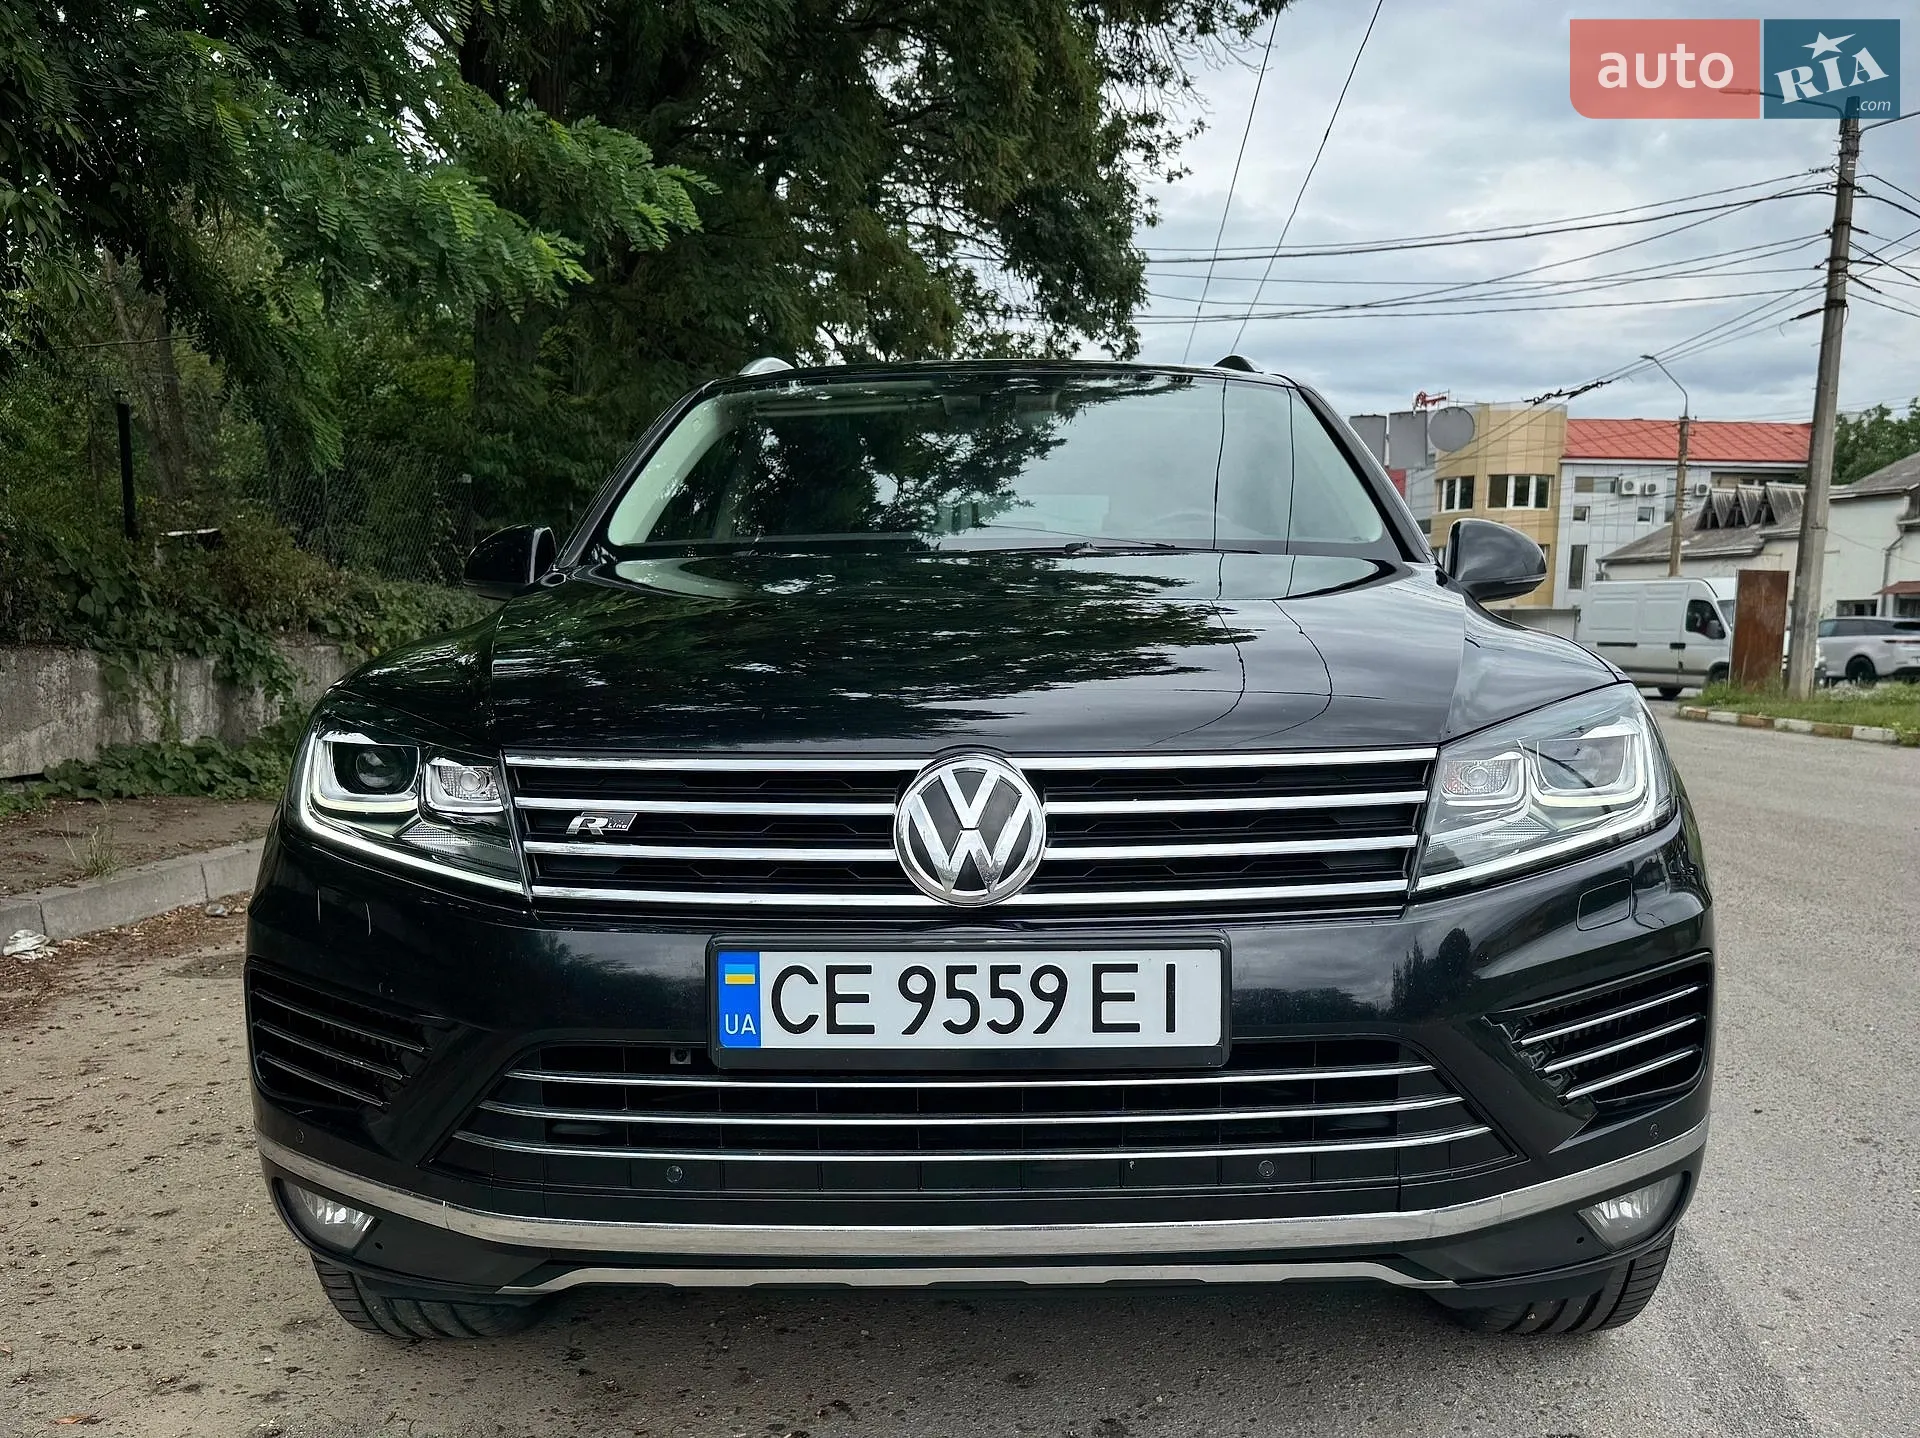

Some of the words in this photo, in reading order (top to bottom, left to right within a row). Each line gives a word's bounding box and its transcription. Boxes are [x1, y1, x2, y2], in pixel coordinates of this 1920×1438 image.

[770, 964, 875, 1034] CE
[897, 964, 1068, 1034] 9559
[1092, 963, 1176, 1033] EI
[725, 1014, 756, 1034] UA
